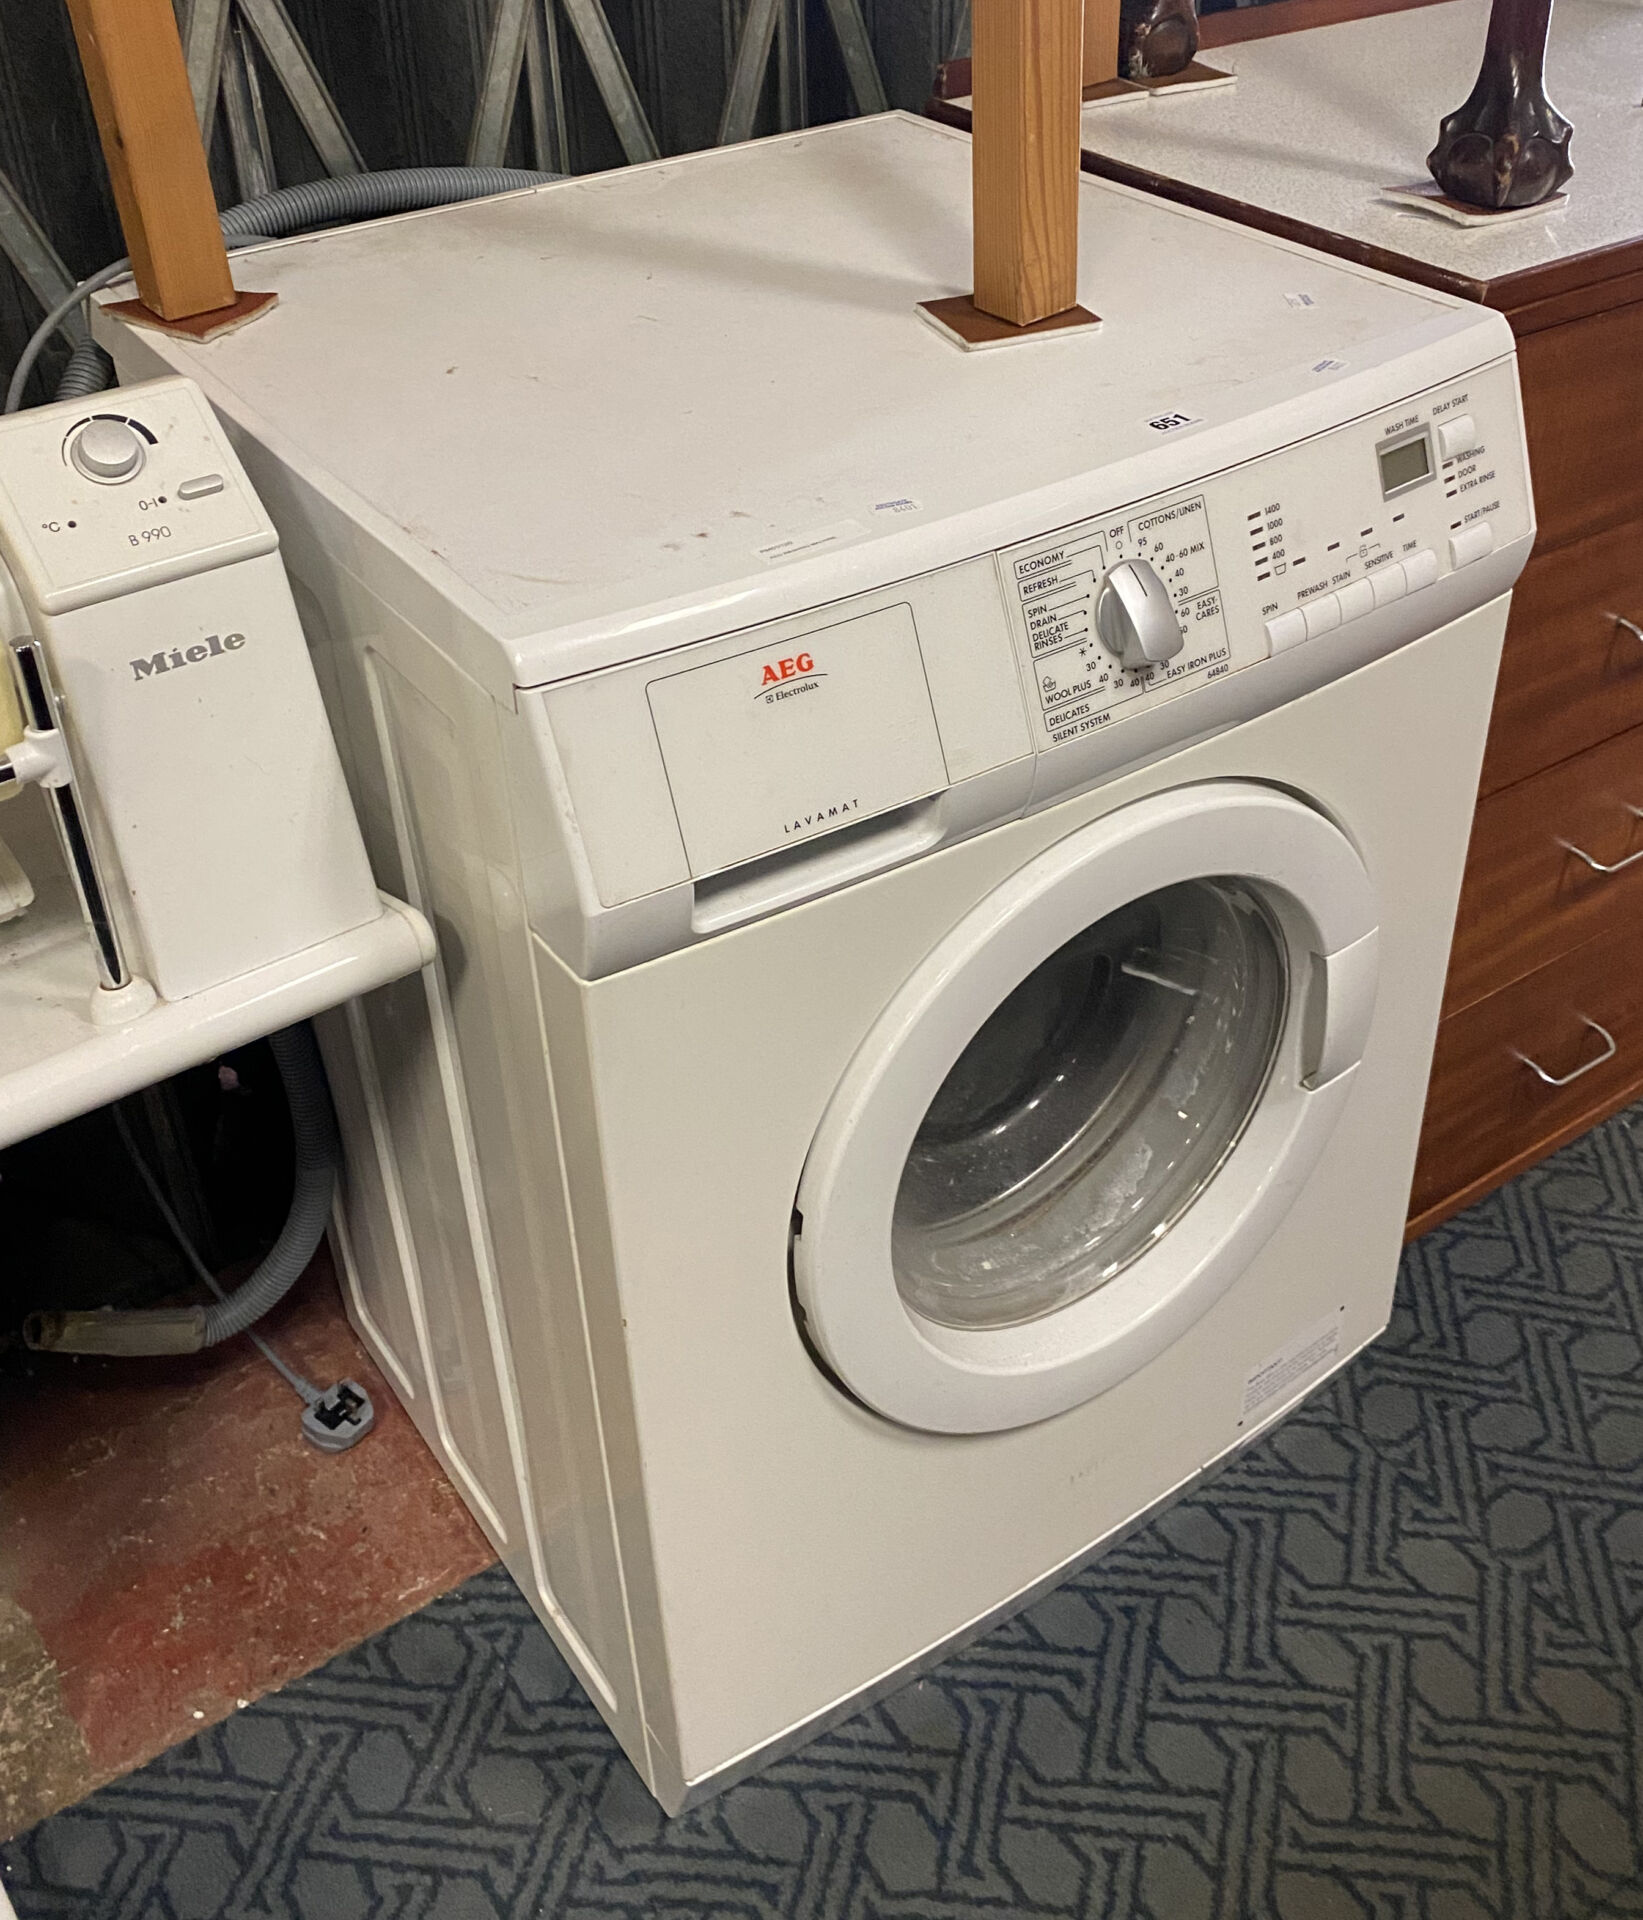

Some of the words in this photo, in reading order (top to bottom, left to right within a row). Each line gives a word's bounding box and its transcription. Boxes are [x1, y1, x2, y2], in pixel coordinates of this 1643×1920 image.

[1432, 403, 1450, 415] DELAY
[1452, 394, 1468, 408] START
[1149, 414, 1191, 430] 651
[1385, 422, 1404, 435] WASH
[1405, 415, 1419, 426] TIME
[1456, 446, 1485, 464] WASHING
[1458, 464, 1476, 478] DOOR
[1460, 478, 1478, 492] EXTRA
[1479, 471, 1495, 483] RINSE
[1138, 501, 1202, 531] COTTONS/LINEN
[1265, 503, 1280, 515] 1400
[1464, 500, 1500, 523] START/PAUSE
[1268, 518, 1283, 530] 1000
[128, 534, 140, 546] B
[142, 526, 172, 543] 990
[1109, 526, 1124, 538] OFF
[1138, 537, 1147, 547] 95
[1154, 542, 1163, 552] 60
[1190, 542, 1205, 554] MIX
[1402, 540, 1417, 552] TIME
[1272, 549, 1285, 560] 400
[1365, 551, 1393, 569] SENSITIVE
[1019, 551, 1064, 574] ECONOMY
[1175, 568, 1184, 577] 40
[1332, 570, 1350, 584] STAIN
[1023, 576, 1058, 595] REFRESH
[1179, 586, 1188, 596] 30
[1297, 581, 1328, 600] PREWASH
[1028, 604, 1047, 618] SPIN
[1181, 608, 1190, 617] 60
[1196, 605, 1220, 620] CARES
[1262, 602, 1278, 615] SPIN
[1030, 614, 1057, 630] DRAIN
[1032, 622, 1069, 642] DELICATE
[1034, 634, 1062, 650] RINSES
[129, 632, 246, 681] Miele
[1167, 664, 1185, 679] EASY
[1188, 657, 1207, 670] IRON
[1209, 648, 1226, 661] PLUS
[761, 652, 814, 686] AEG
[1086, 662, 1096, 672] 30
[1160, 660, 1169, 670] 30
[1207, 664, 1228, 679] 64840
[1099, 673, 1109, 683] 40
[1114, 679, 1123, 688] 30
[1130, 678, 1139, 687] 40
[1146, 672, 1154, 681] 40
[776, 680, 819, 700] Electrolux
[1046, 688, 1072, 704] WOOL
[1073, 680, 1092, 693] PLUS
[1049, 704, 1090, 726] DELICATES
[1053, 726, 1078, 742] SILENT
[1080, 713, 1110, 732] SYSTEM
[784, 798, 859, 833] LAVAMAT
